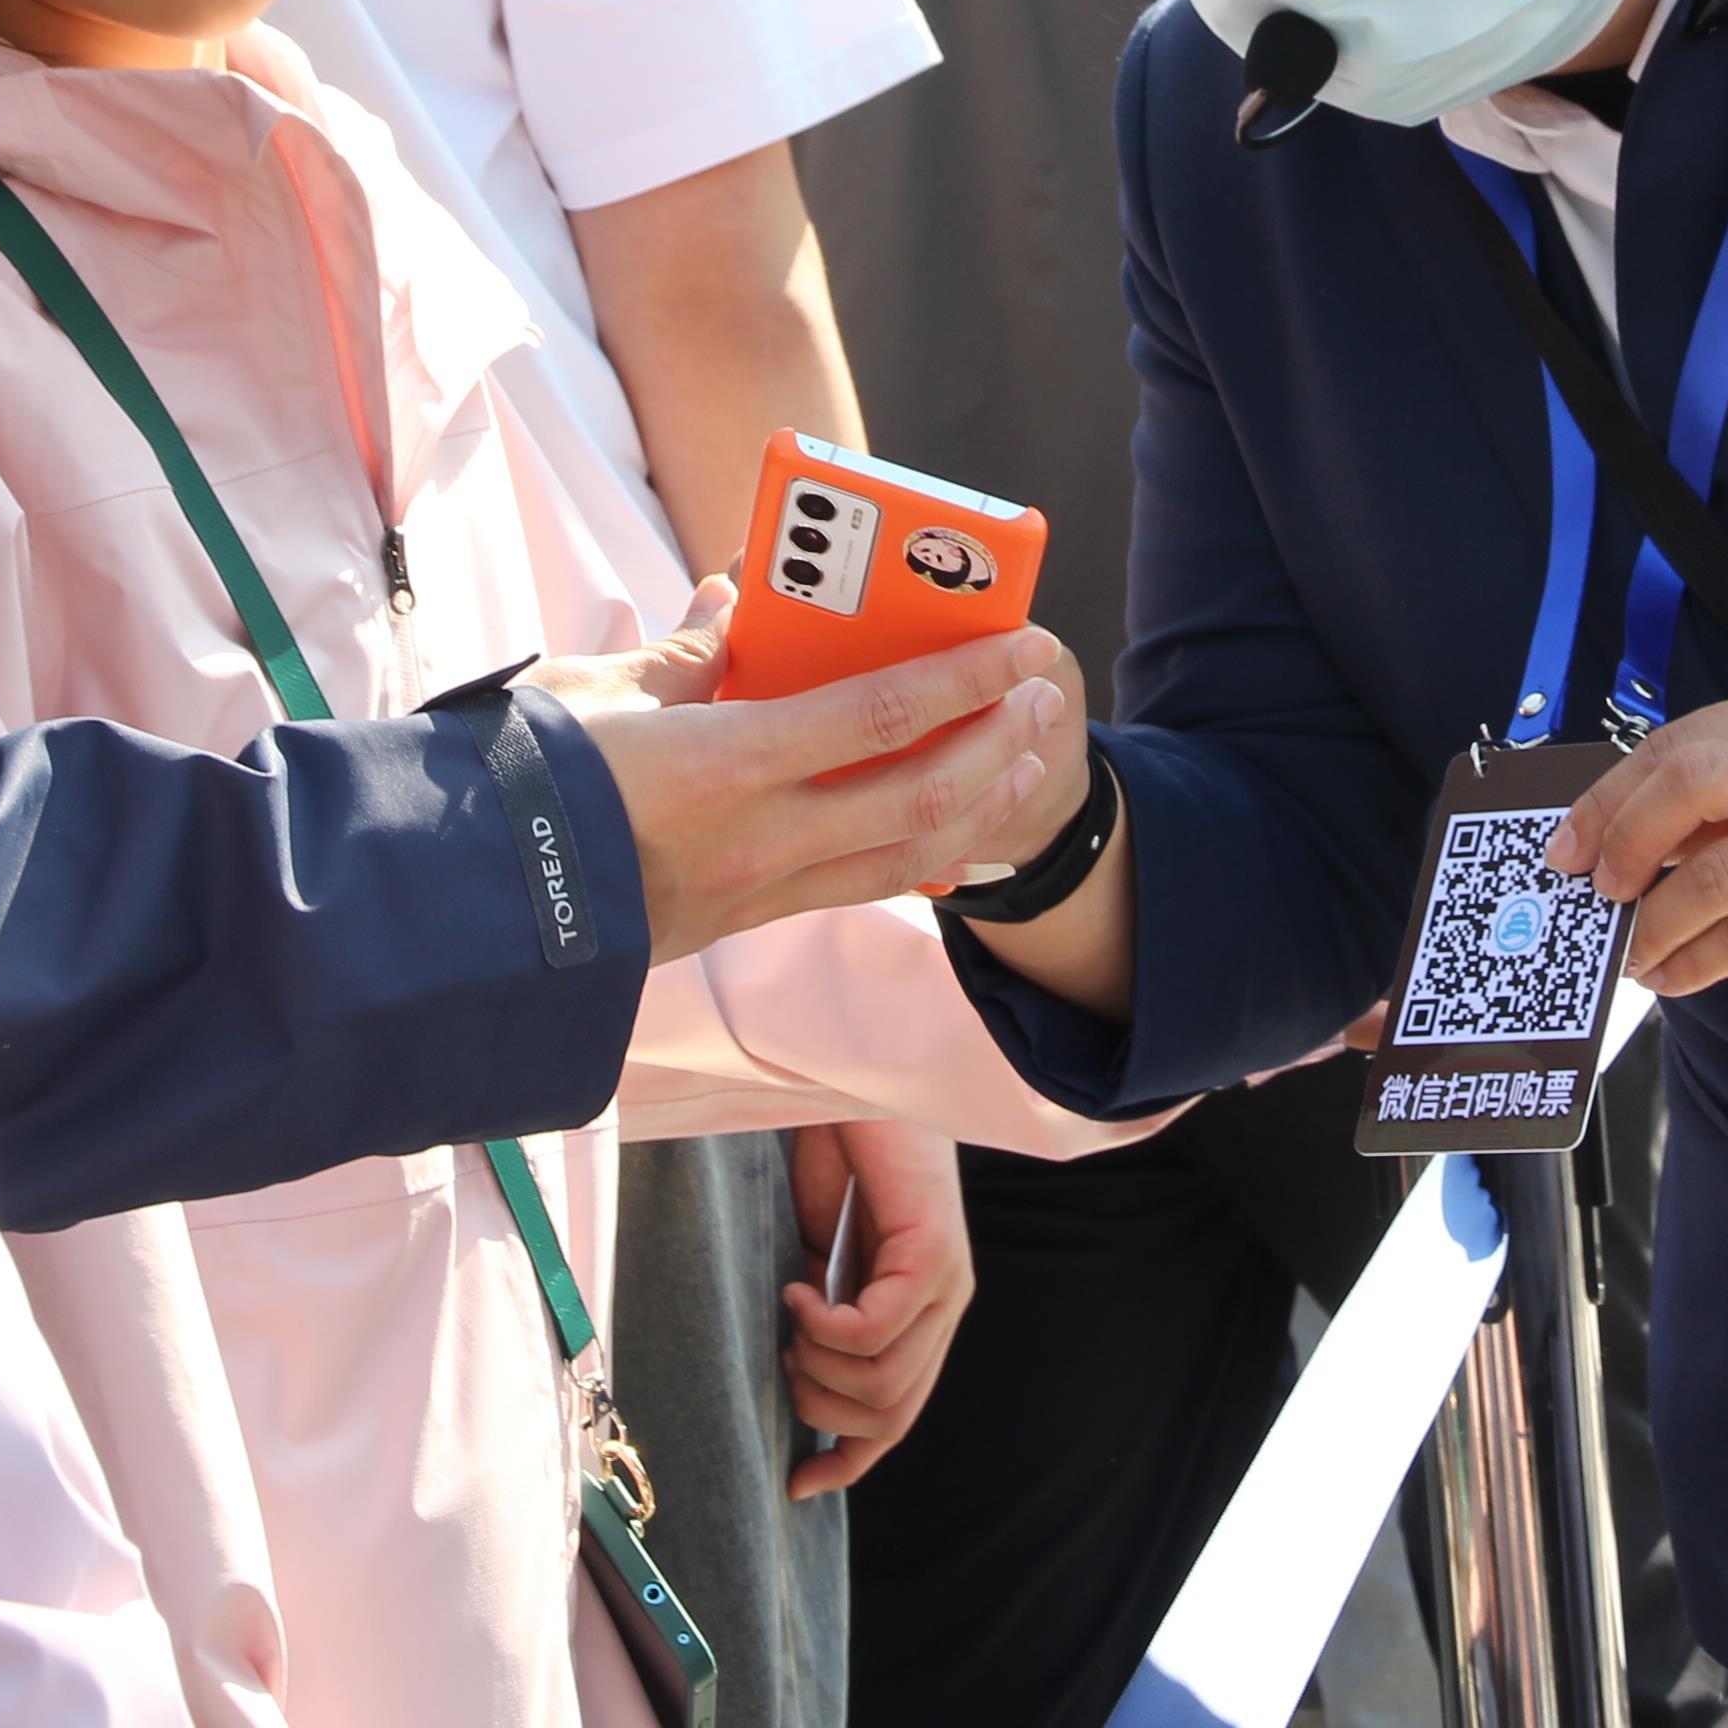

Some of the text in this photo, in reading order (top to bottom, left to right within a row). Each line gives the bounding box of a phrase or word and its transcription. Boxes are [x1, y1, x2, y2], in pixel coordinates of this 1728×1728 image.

[531, 815, 578, 948] TOREAD
[1377, 1069, 1578, 1122] 微信扫码购票
